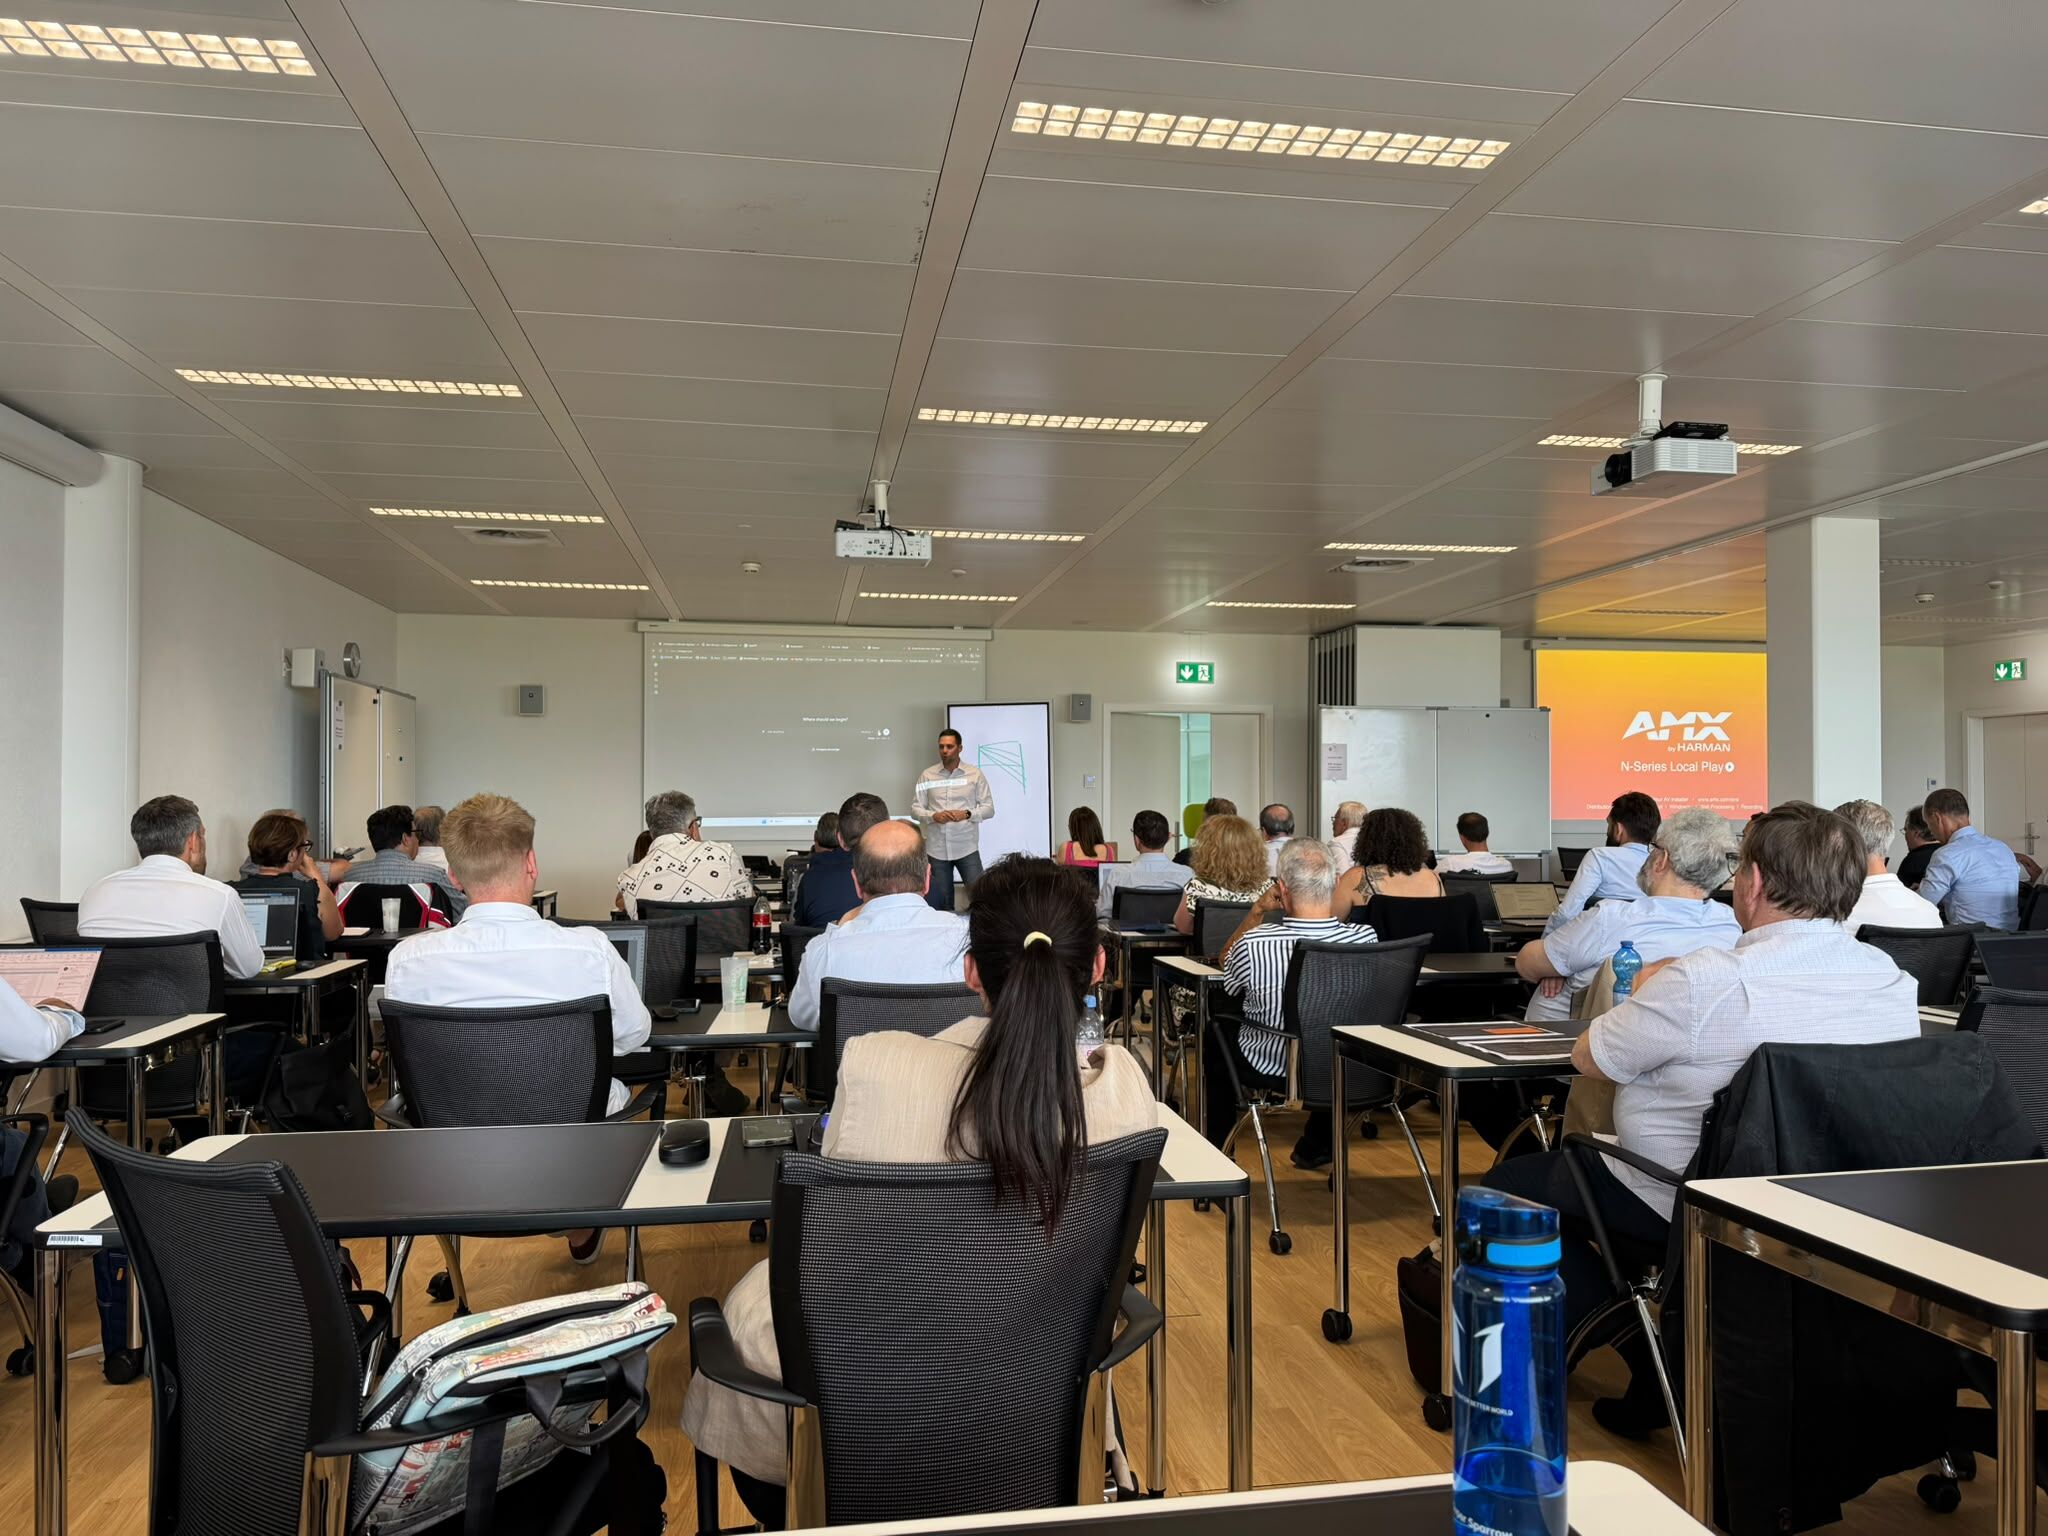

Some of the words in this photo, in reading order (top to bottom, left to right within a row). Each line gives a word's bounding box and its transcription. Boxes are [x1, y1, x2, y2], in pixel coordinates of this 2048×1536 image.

[1622, 711, 1733, 741] AMX
[1677, 743, 1731, 752] HARMAN
[1620, 761, 1668, 772] N-Series
[1670, 761, 1698, 772] Local
[1701, 761, 1724, 774] Play
